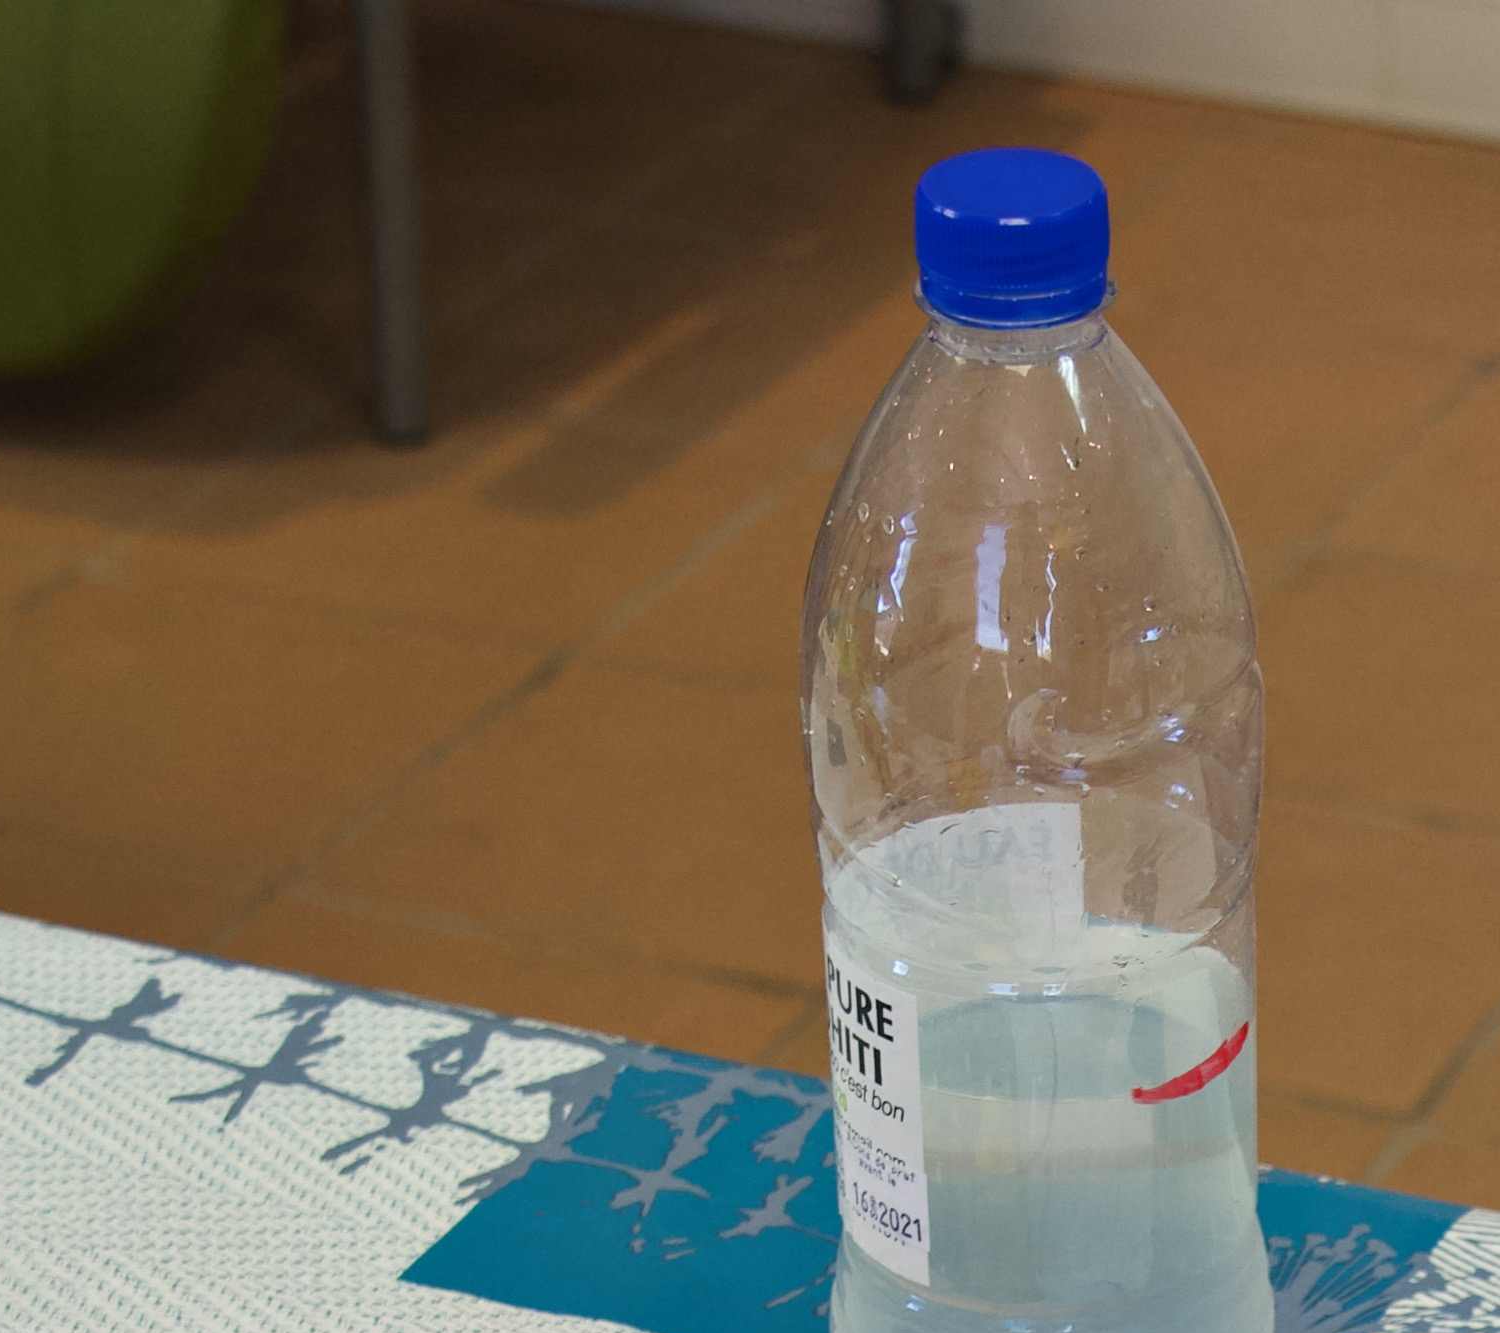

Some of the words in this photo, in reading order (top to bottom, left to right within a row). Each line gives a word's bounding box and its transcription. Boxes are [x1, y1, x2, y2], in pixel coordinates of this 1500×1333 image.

[827, 953, 894, 1043] PURE
[829, 1006, 883, 1087] HITI
[870, 1088, 906, 1123] bon
[878, 1200, 923, 1243] 2021
